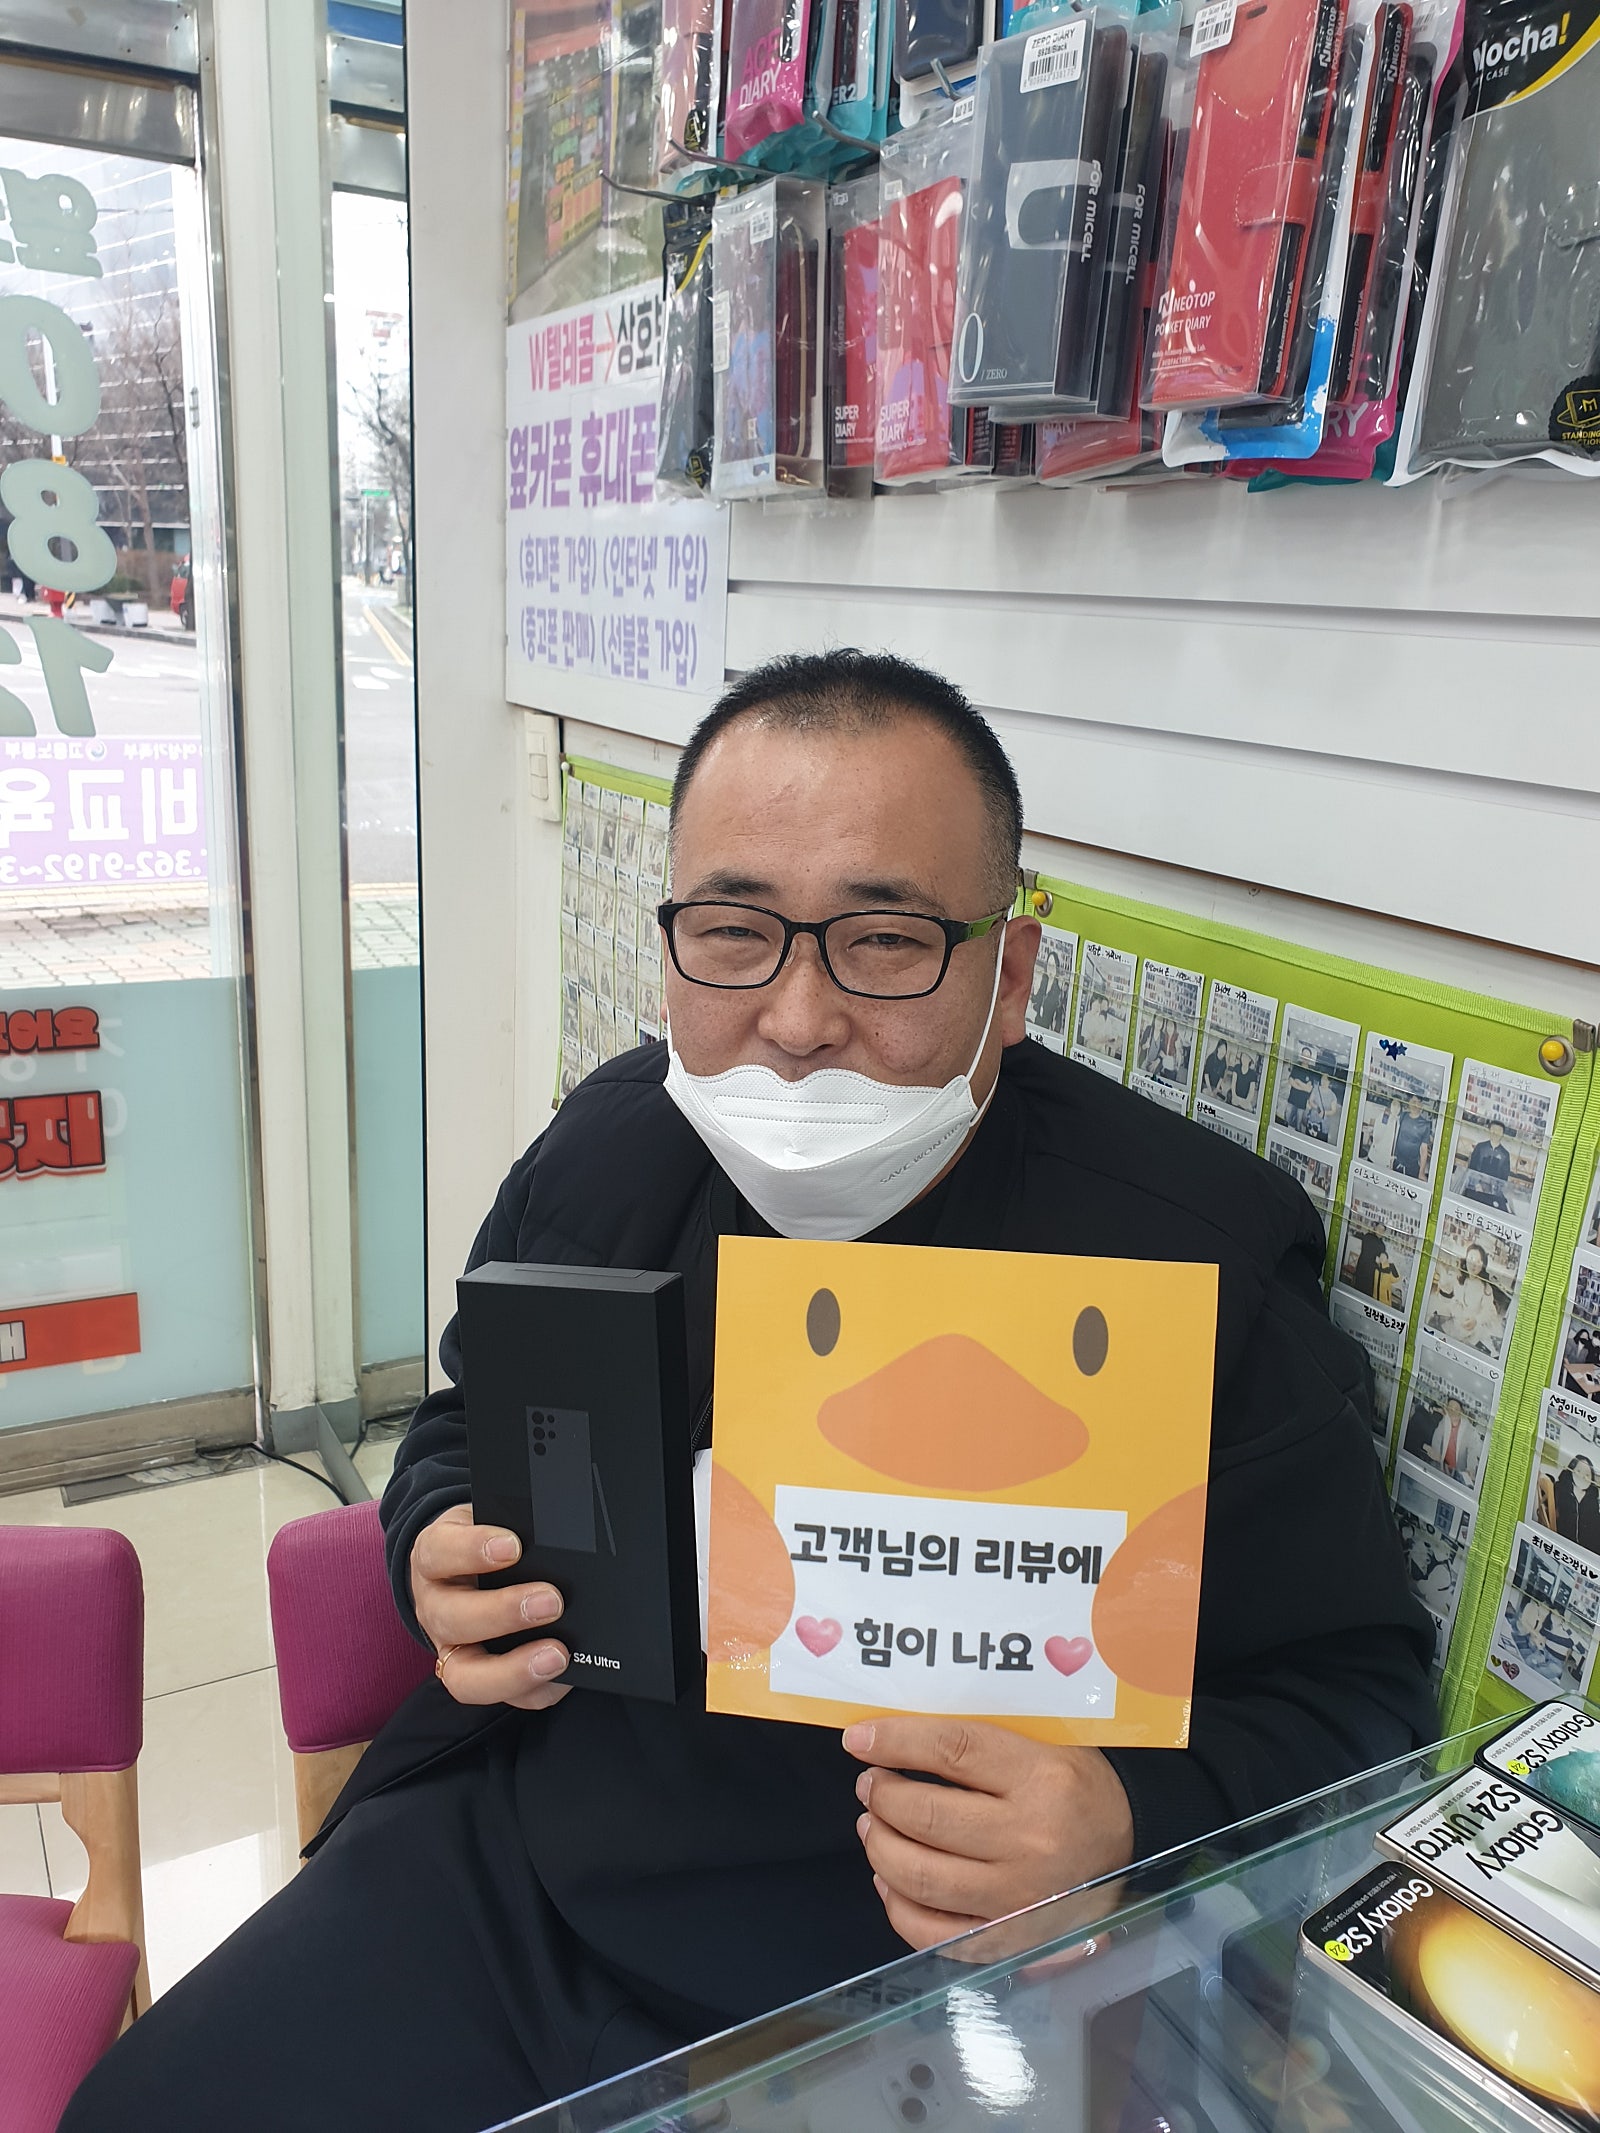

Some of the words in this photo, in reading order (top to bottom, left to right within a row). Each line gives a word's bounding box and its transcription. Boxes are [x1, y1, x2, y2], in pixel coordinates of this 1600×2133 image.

[738, 61, 782, 111] DIARY
[1486, 66, 1510, 81] CASE
[1088, 160, 1102, 196] FOR
[1133, 184, 1146, 220] FOR
[1173, 290, 1216, 312] NEOTOP
[1186, 314, 1211, 331] DIARY
[529, 313, 595, 392] W텔레콤
[617, 299, 662, 375] 상호
[986, 368, 1008, 381] ZERO
[835, 404, 859, 421] SUPER
[880, 400, 910, 423] SUPER
[835, 422, 857, 438] DIARY
[880, 422, 907, 444] DIARY
[510, 417, 572, 510] 옆커폰
[580, 403, 657, 508] 휴대폰
[519, 533, 560, 593] (휴대폰
[564, 534, 597, 595] 가입)
[603, 534, 658, 600] (인터넷
[664, 533, 708, 602] 가입)
[521, 606, 558, 664] (중고폰
[562, 609, 596, 667] 판매)
[602, 612, 649, 680] (선불폰
[655, 618, 698, 687] 가입)
[880, 1162, 911, 1183] SAVE
[790, 1522, 960, 1577] 고객님의
[974, 1538, 1103, 1584] 리뷰에
[574, 1652, 592, 1665] S24
[593, 1655, 621, 1670] Ultra
[854, 1617, 938, 1668] 힘이
[952, 1631, 1034, 1671] 나요
[1531, 1714, 1595, 1755] Galaxy
[1509, 1748, 1547, 1775] S2
[1466, 1783, 1521, 1822] S24
[1411, 1813, 1485, 1862] Ultra
[1465, 1810, 1564, 1880] Galaxy
[1357, 1878, 1434, 1935] Galaxy
[1336, 1926, 1373, 1961] S2
